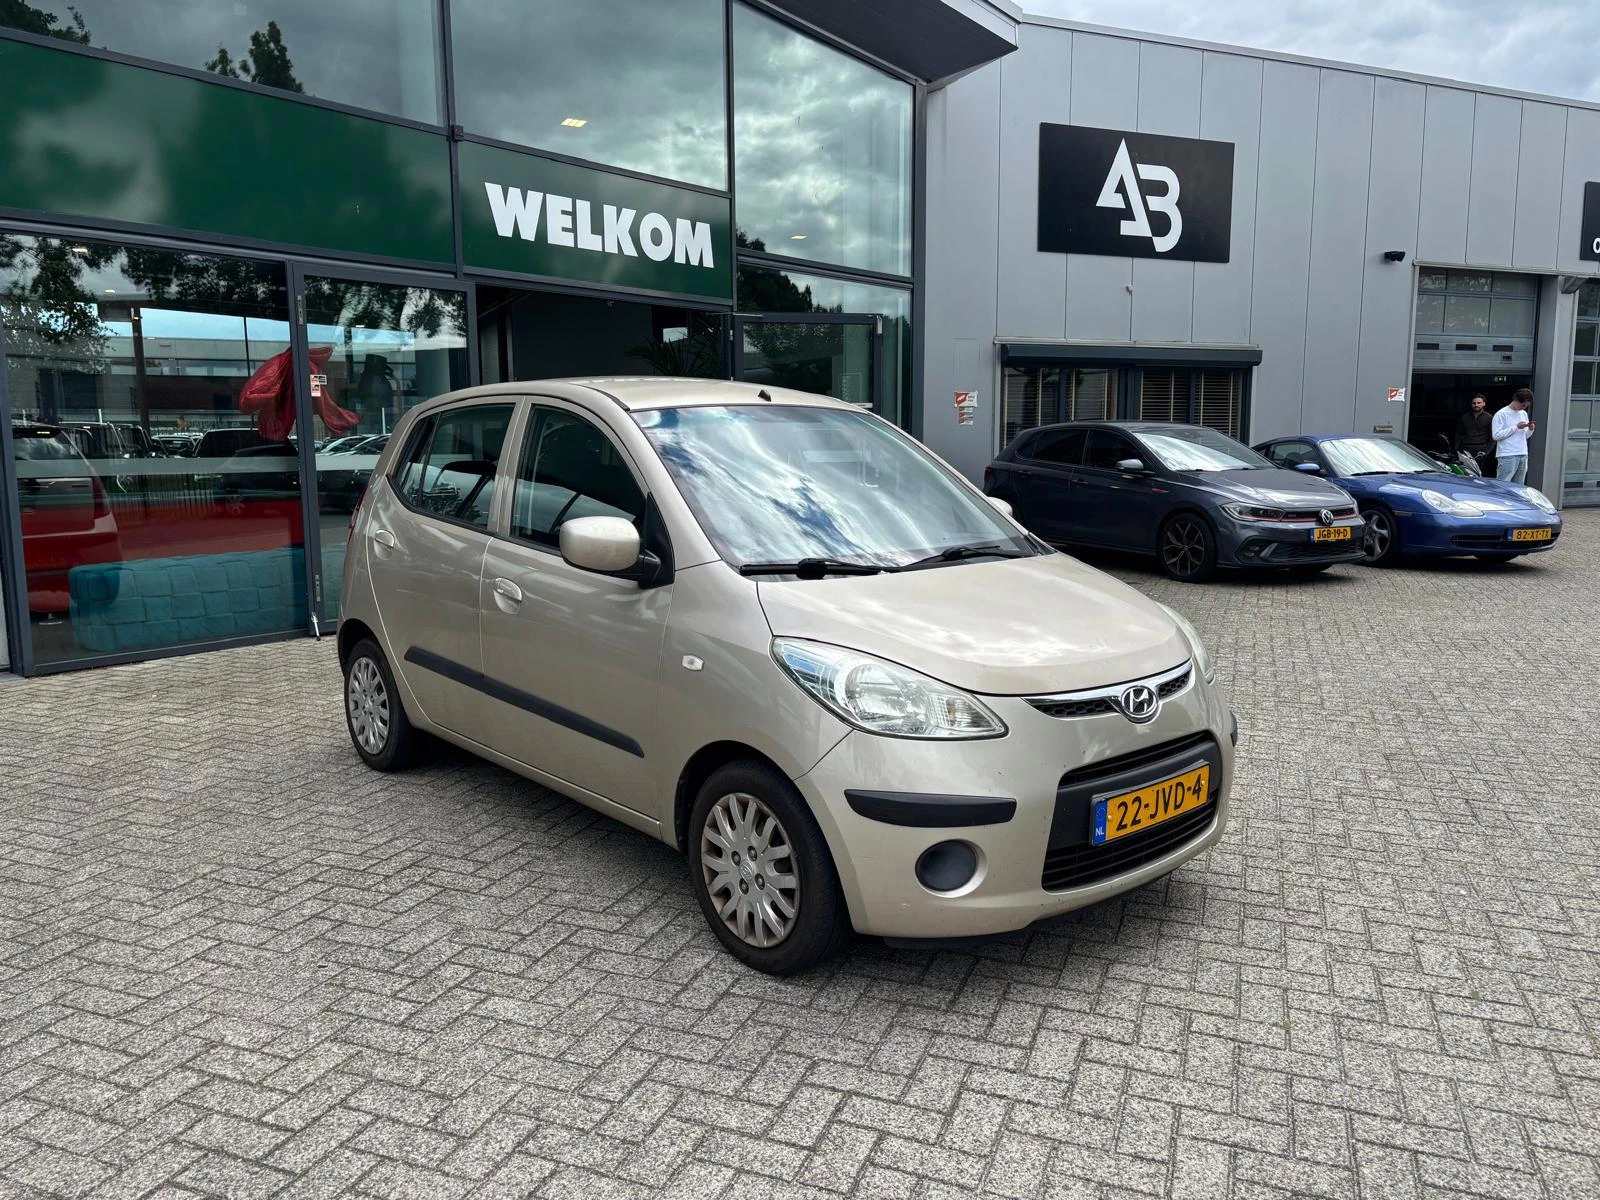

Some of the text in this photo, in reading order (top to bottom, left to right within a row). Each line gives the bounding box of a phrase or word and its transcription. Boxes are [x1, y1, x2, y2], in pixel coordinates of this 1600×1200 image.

[484, 181, 715, 269] WELKOM
[1316, 528, 1348, 539] JGB-19-D
[1115, 773, 1202, 832] 22-JVD-4
[1095, 826, 1105, 837] NL
